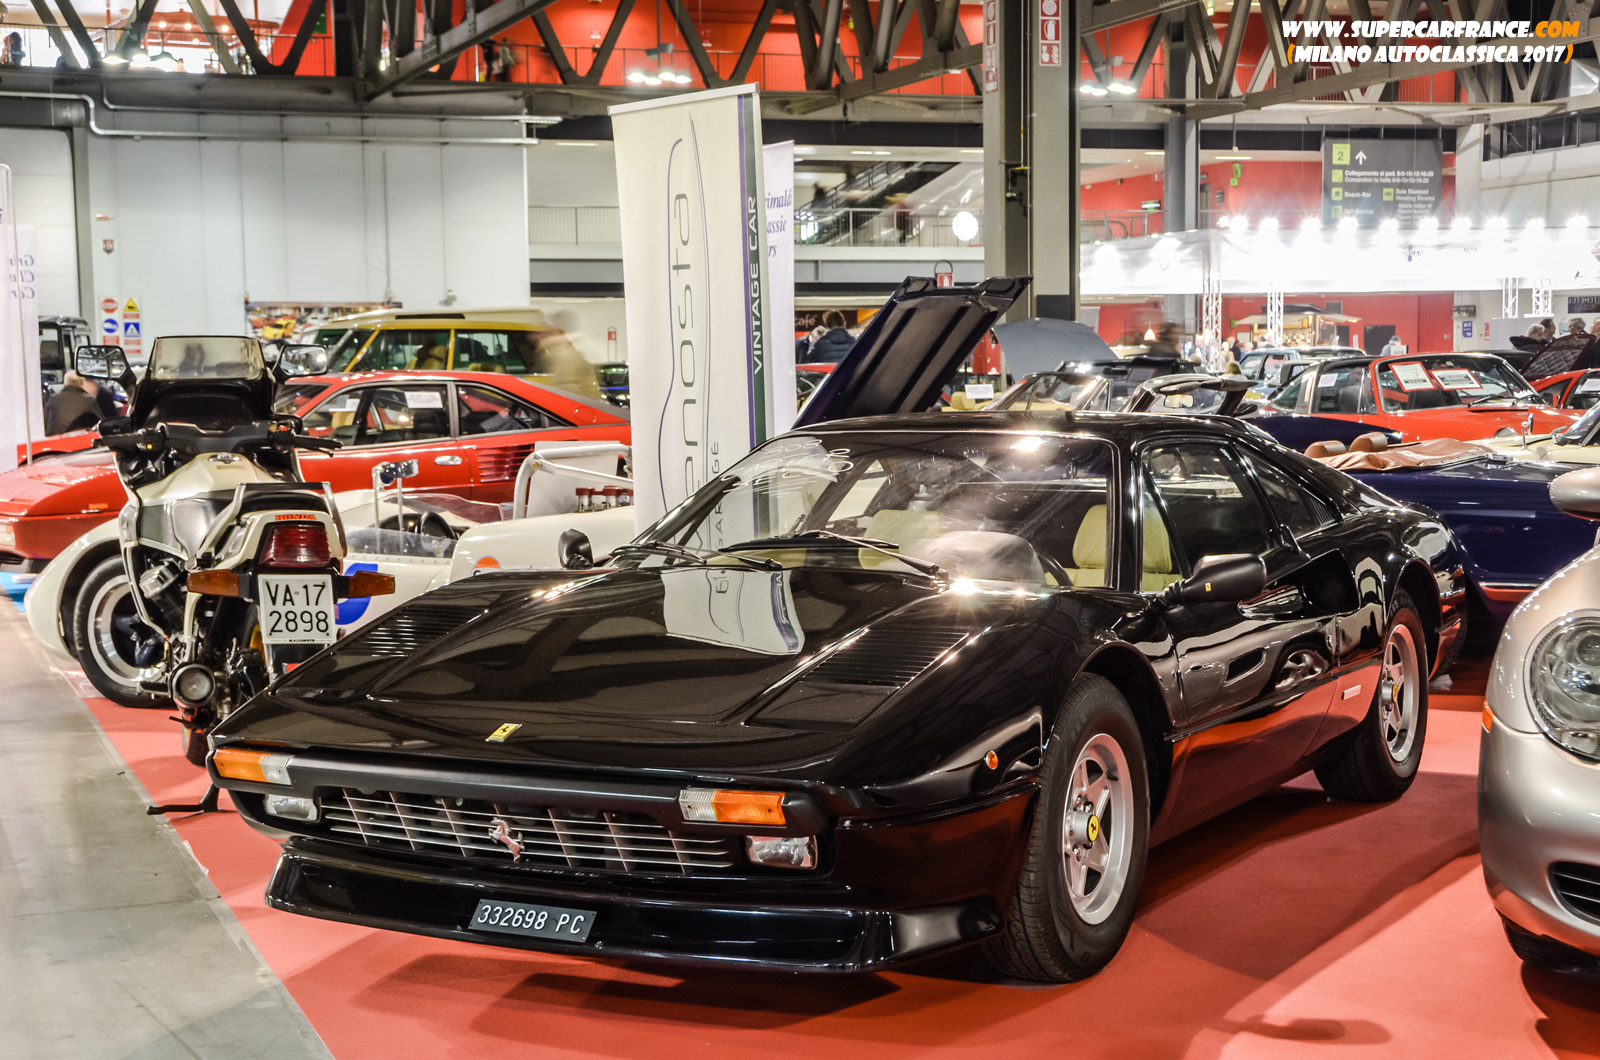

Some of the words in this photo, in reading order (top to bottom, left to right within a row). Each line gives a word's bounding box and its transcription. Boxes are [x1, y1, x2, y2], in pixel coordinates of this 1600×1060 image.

[1337, 151, 1344, 161] 2
[1344, 170, 1379, 178] Collegamento
[748, 196, 758, 251] CAR
[766, 215, 787, 234] assic
[749, 262, 763, 375] VINTAGE
[710, 441, 724, 549] GARGE
[265, 584, 295, 606] VA
[302, 584, 326, 606] 17
[268, 610, 330, 633] 2898
[477, 904, 548, 930] 332698
[555, 913, 585, 934] PC
